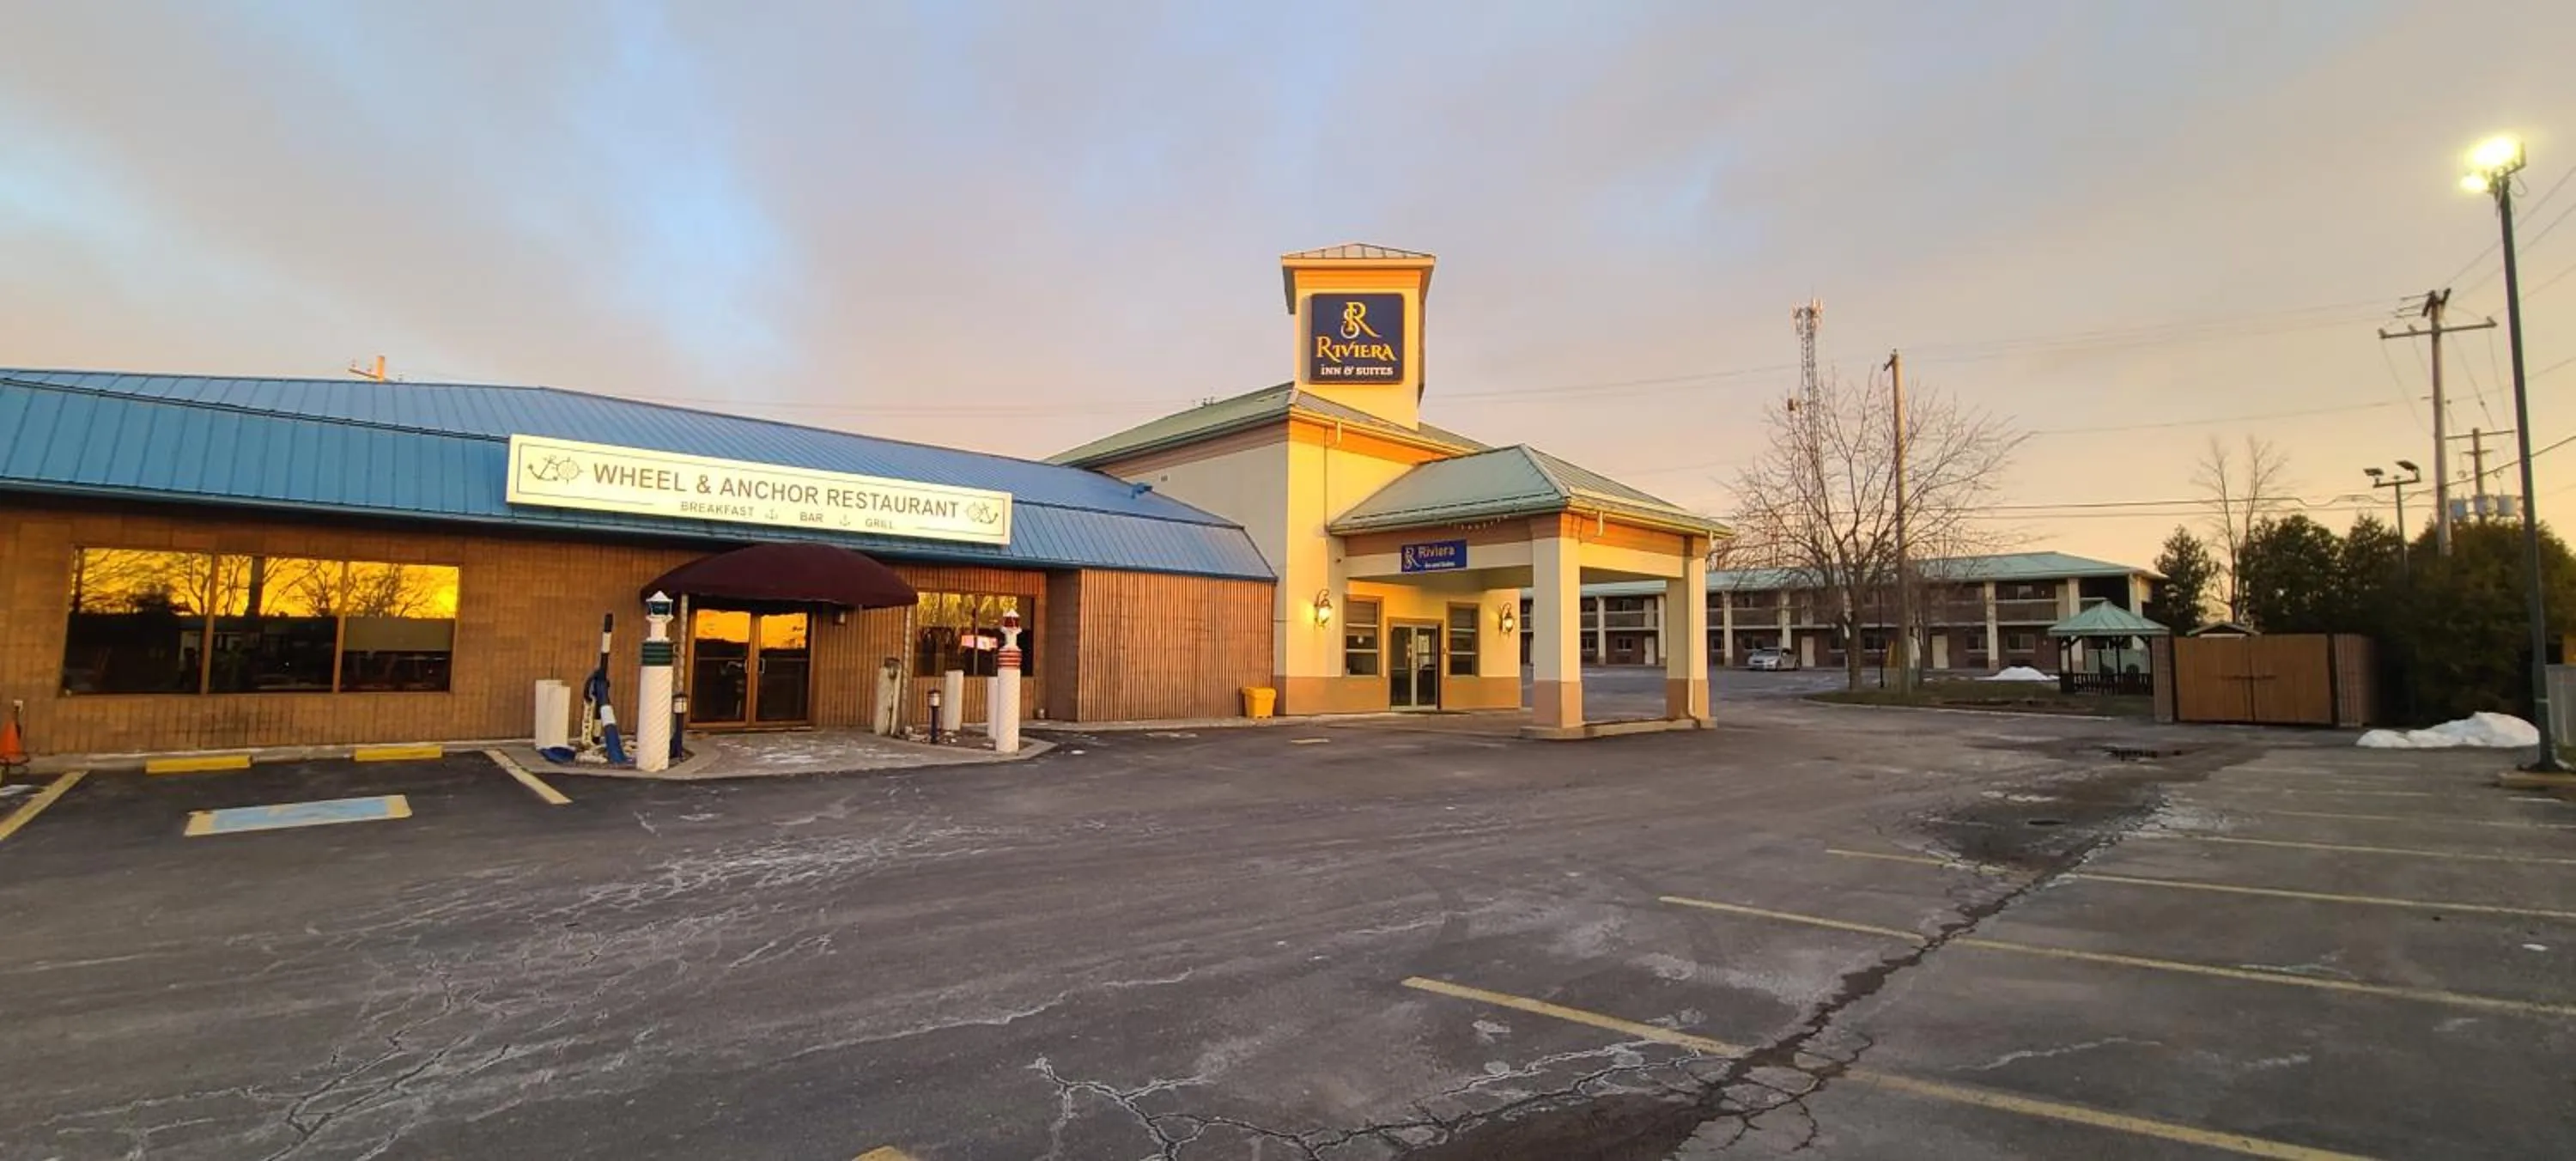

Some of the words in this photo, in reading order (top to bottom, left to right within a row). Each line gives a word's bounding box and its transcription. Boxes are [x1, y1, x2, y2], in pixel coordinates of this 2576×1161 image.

[1315, 336, 1397, 362] RIVIERA
[1344, 366, 1354, 375] &
[1356, 367, 1393, 375] SUITES
[593, 463, 687, 492] WHEEL
[696, 474, 712, 494] &
[720, 477, 818, 505] ANCHOR
[827, 489, 959, 519] RESTAURANT
[680, 501, 754, 517] BREAKFAST
[799, 512, 823, 523] BAR
[865, 518, 894, 530] GRILL
